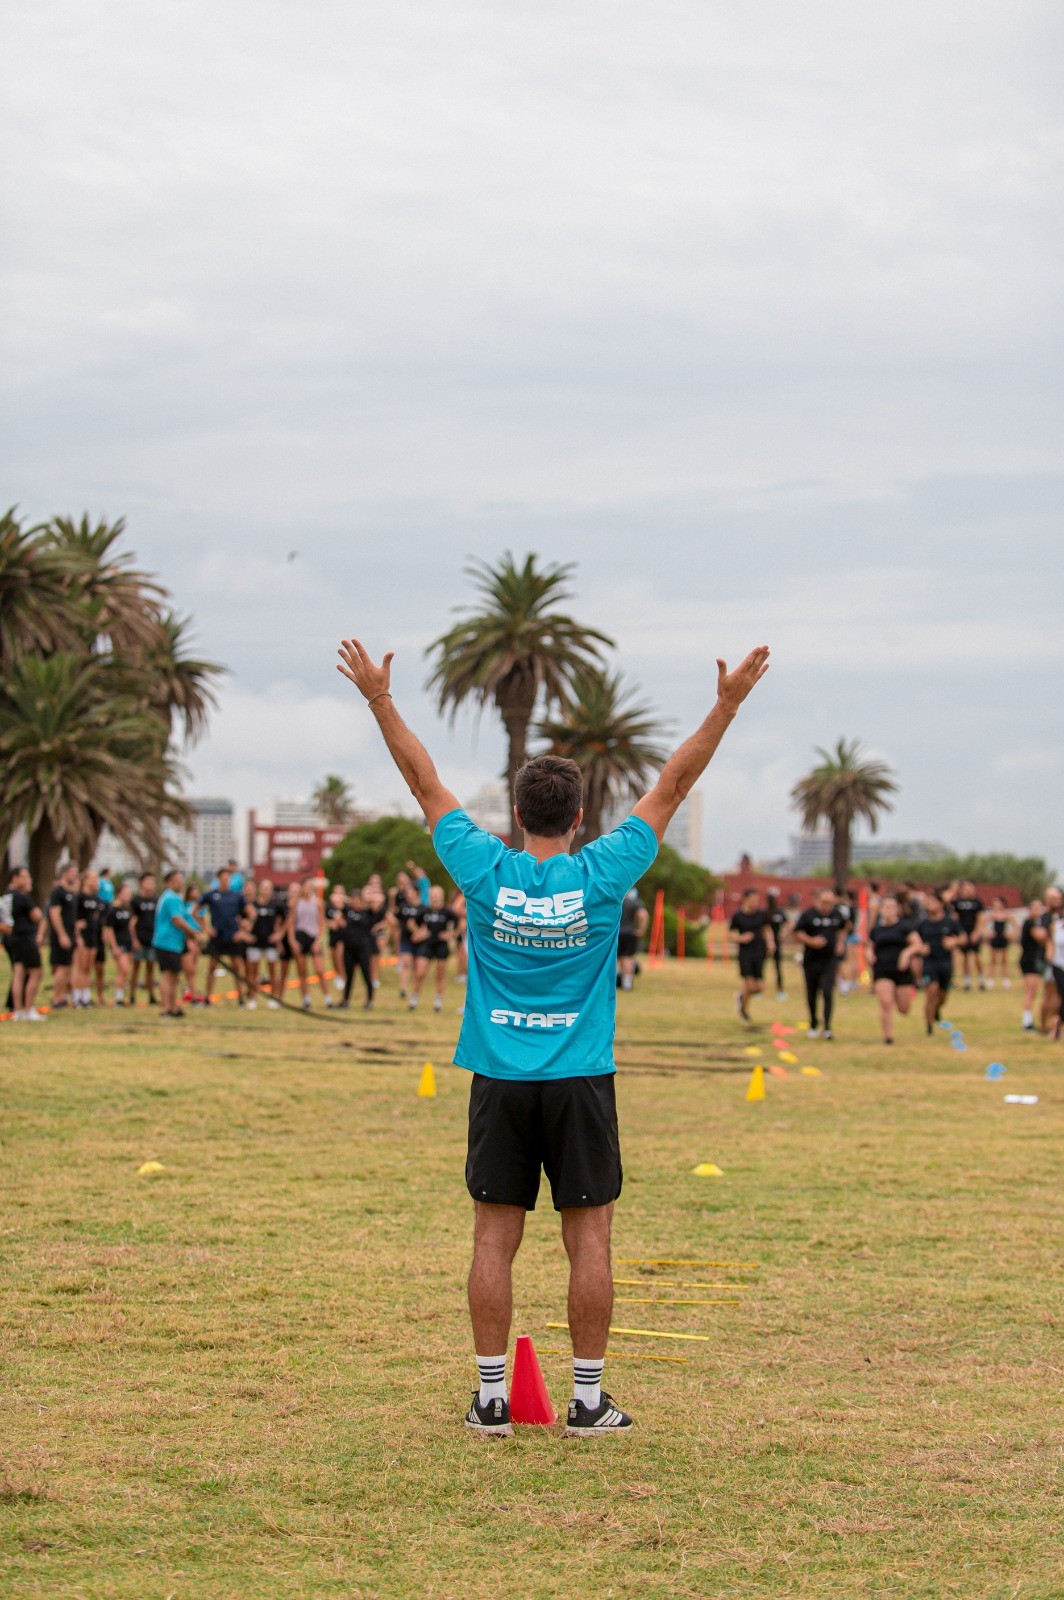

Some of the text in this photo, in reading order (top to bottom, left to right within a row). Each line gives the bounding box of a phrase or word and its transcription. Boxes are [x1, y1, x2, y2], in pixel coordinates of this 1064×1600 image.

[496, 886, 584, 918] PRE
[493, 906, 586, 926] TEMPORADA
[490, 1009, 580, 1028] STAFF
